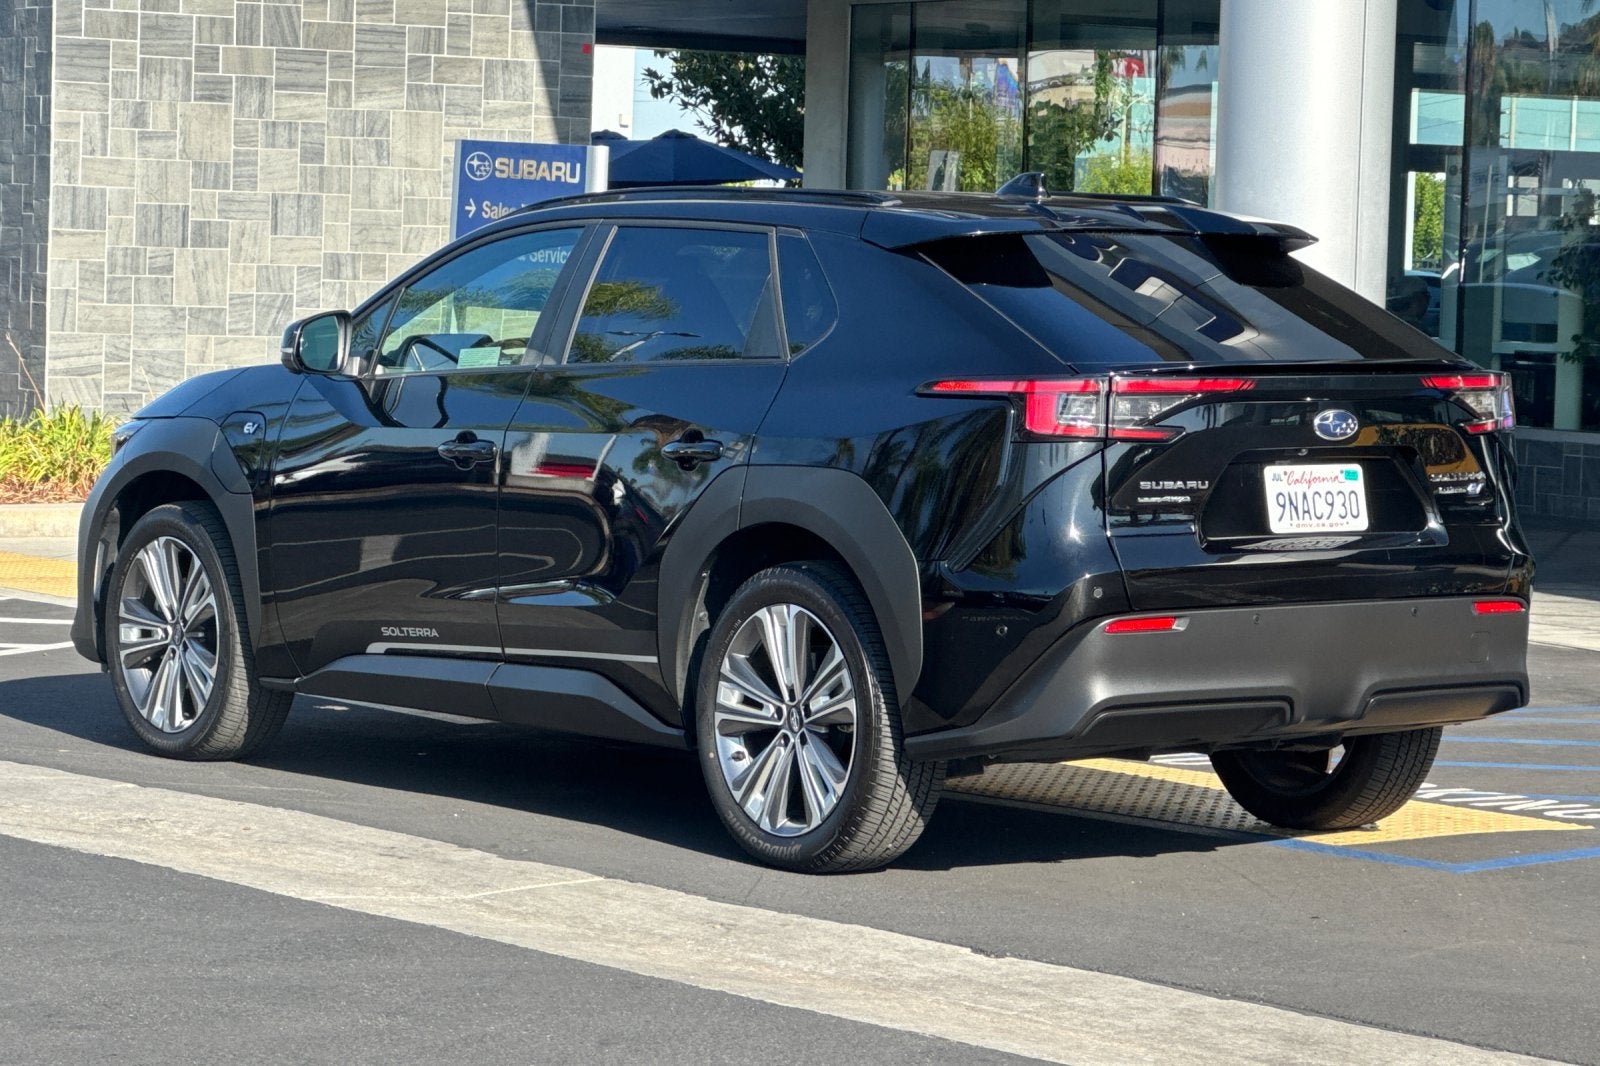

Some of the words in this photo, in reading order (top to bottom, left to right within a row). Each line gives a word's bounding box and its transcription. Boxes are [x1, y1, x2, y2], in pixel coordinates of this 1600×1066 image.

[495, 157, 580, 184] SUBARU
[529, 246, 572, 264] Servic
[1139, 480, 1209, 490] SUBARU
[1287, 470, 1346, 489] California
[1276, 490, 1360, 522] 9NAC930
[381, 626, 440, 638] SOLTERRA
